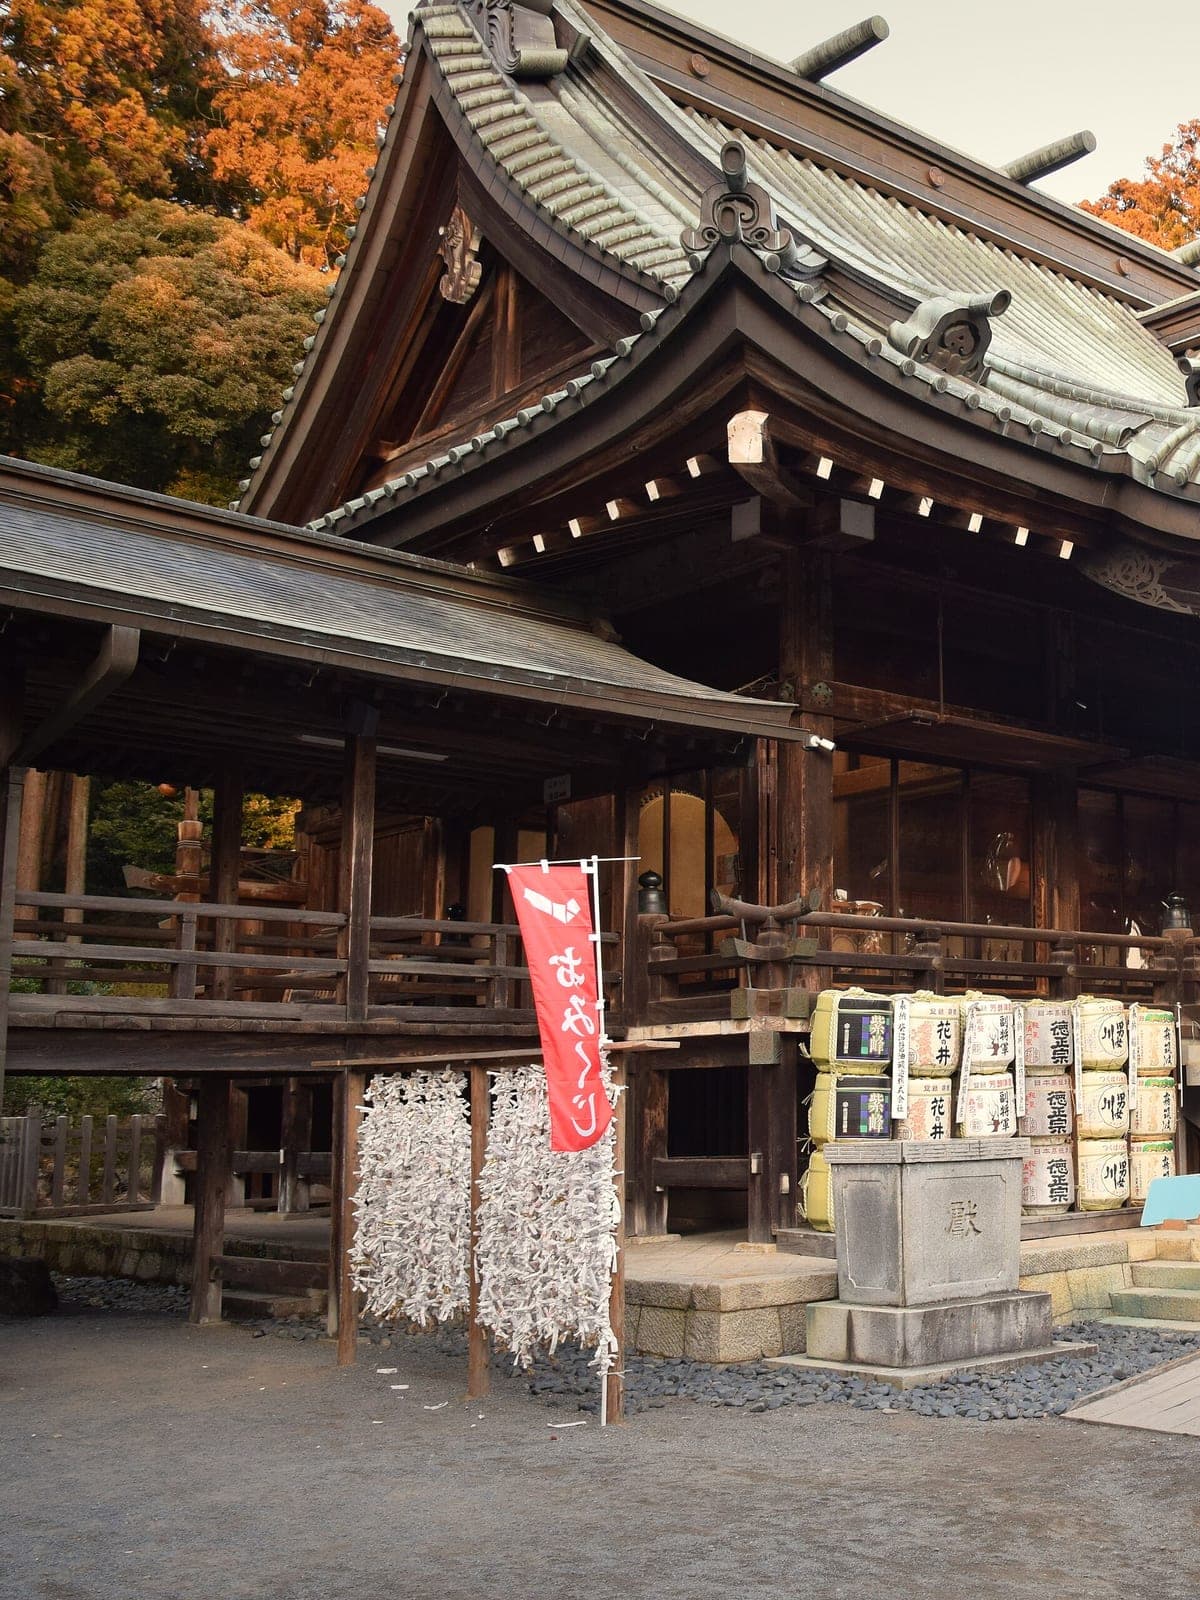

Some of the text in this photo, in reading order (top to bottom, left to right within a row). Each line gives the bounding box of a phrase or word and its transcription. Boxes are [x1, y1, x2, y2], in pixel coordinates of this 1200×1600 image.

[548, 947, 596, 1137] おみくじ
[935, 1020, 952, 1066] 花の井
[999, 1015, 1010, 1056] 副将軍
[930, 1097, 946, 1140] 花の井
[999, 1091, 1010, 1132] 副将軍
